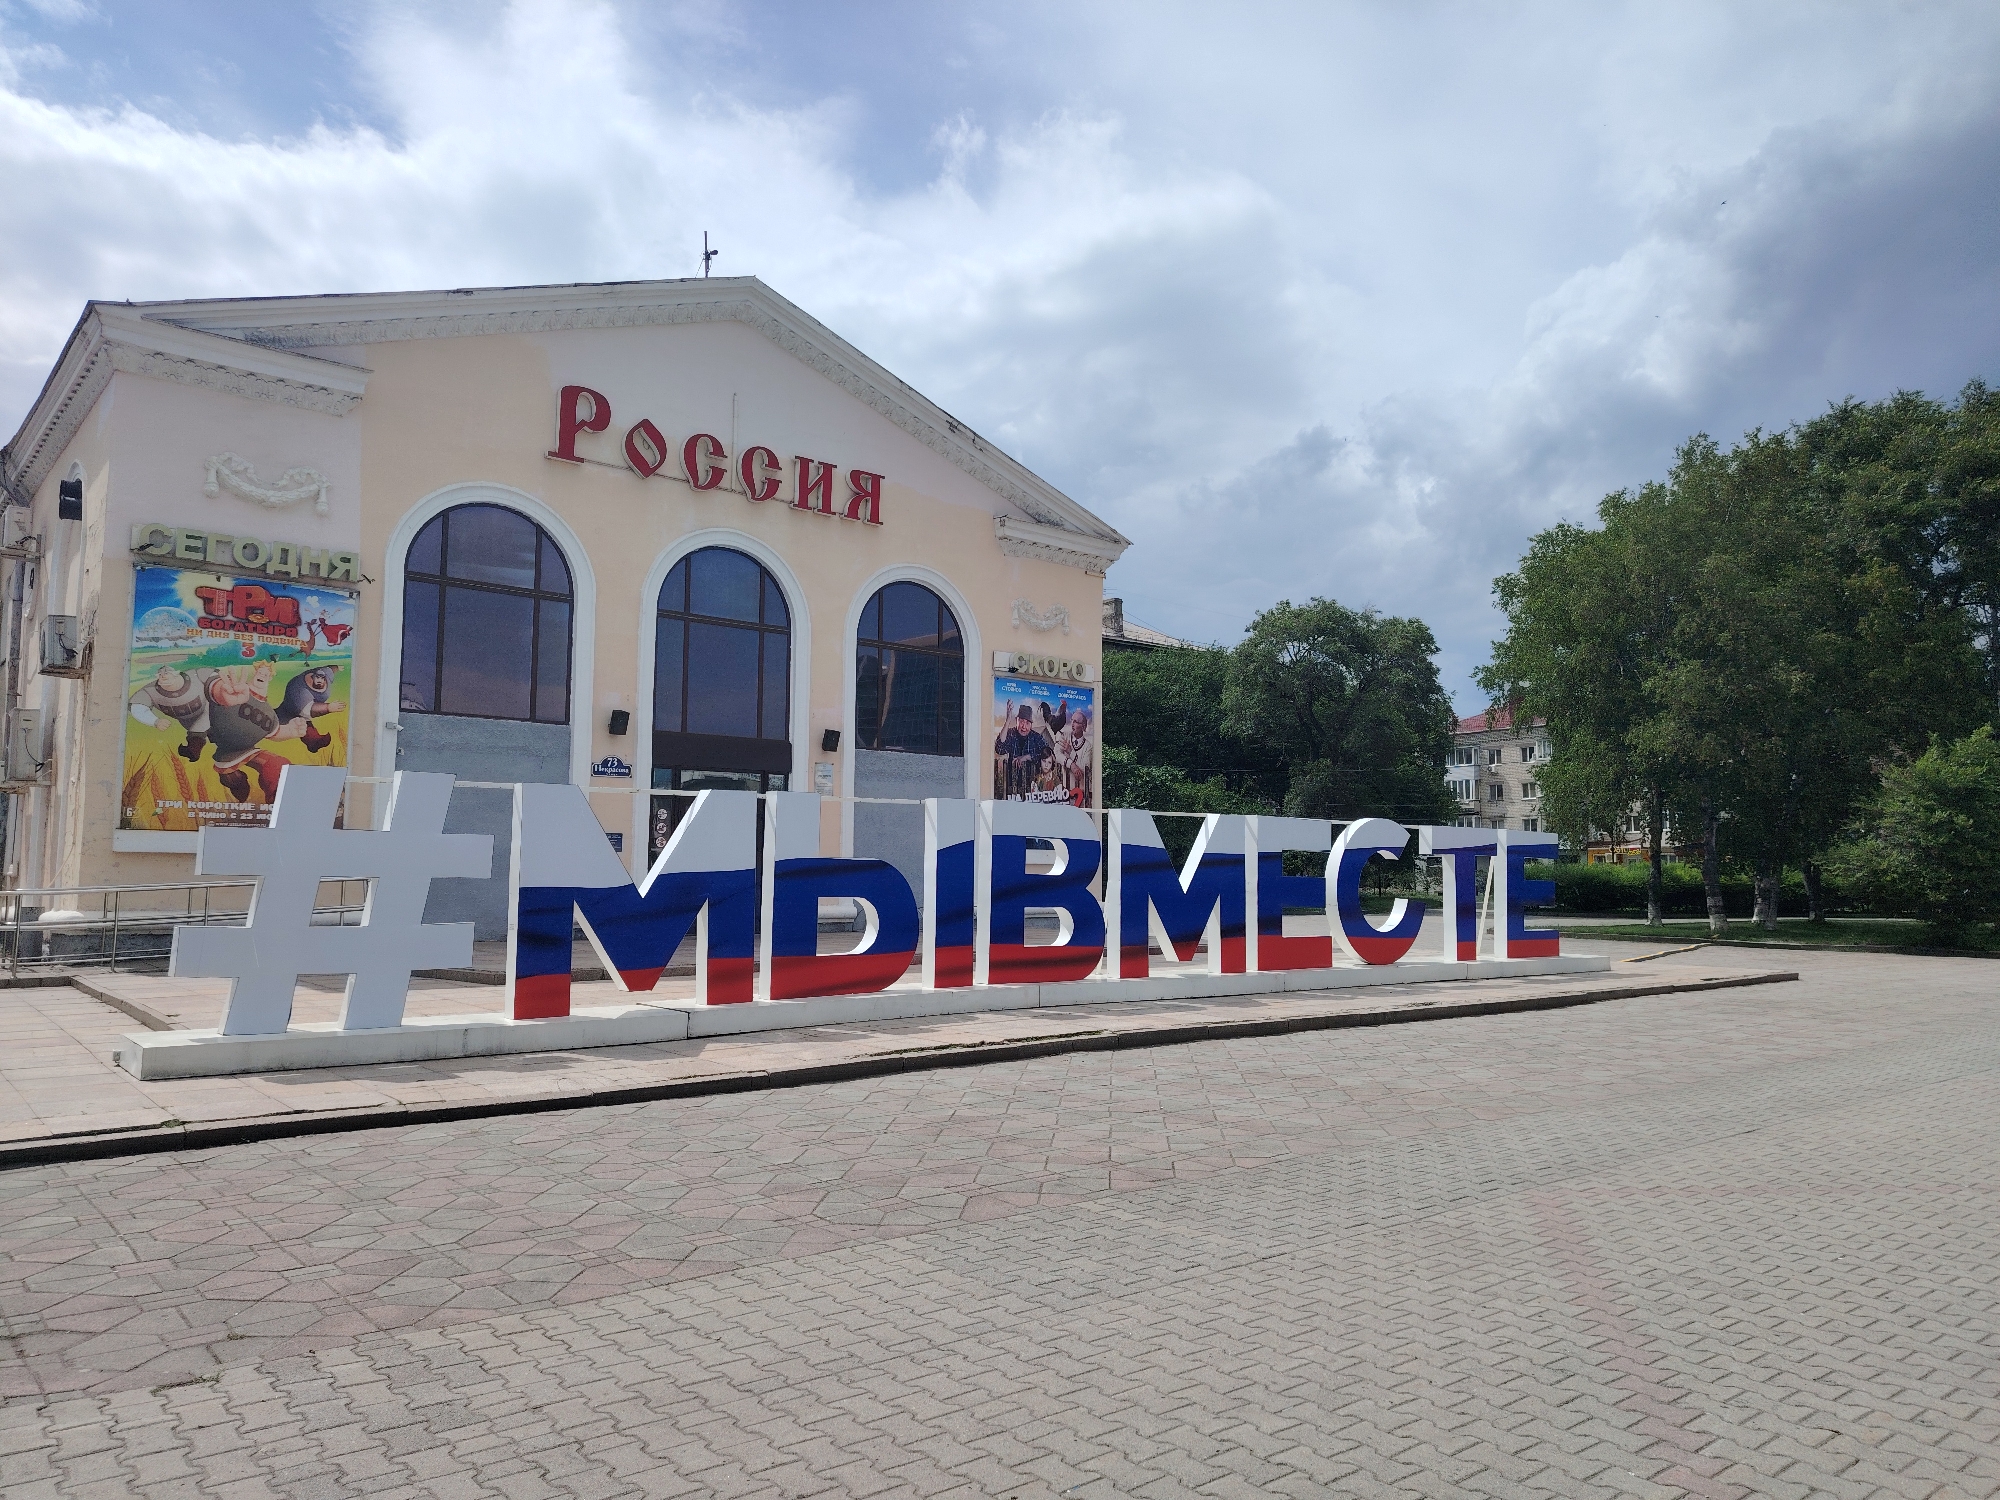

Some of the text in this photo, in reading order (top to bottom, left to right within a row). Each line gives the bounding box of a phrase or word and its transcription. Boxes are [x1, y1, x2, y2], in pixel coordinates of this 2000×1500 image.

[138, 523, 359, 582] СЕГОДНЯ
[195, 585, 301, 625] ТРИ
[198, 617, 298, 637] БОГАТЫРЯ
[187, 628, 307, 648] НИ ДНЯ БЕЗ ПОДВИГА
[241, 642, 256, 657] 3
[1011, 651, 1087, 681] СКОРО
[607, 757, 618, 768] 73
[156, 800, 183, 809] ТРИ
[188, 801, 256, 811] КОРОТКИЕ
[199, 811, 227, 819] КИНО
